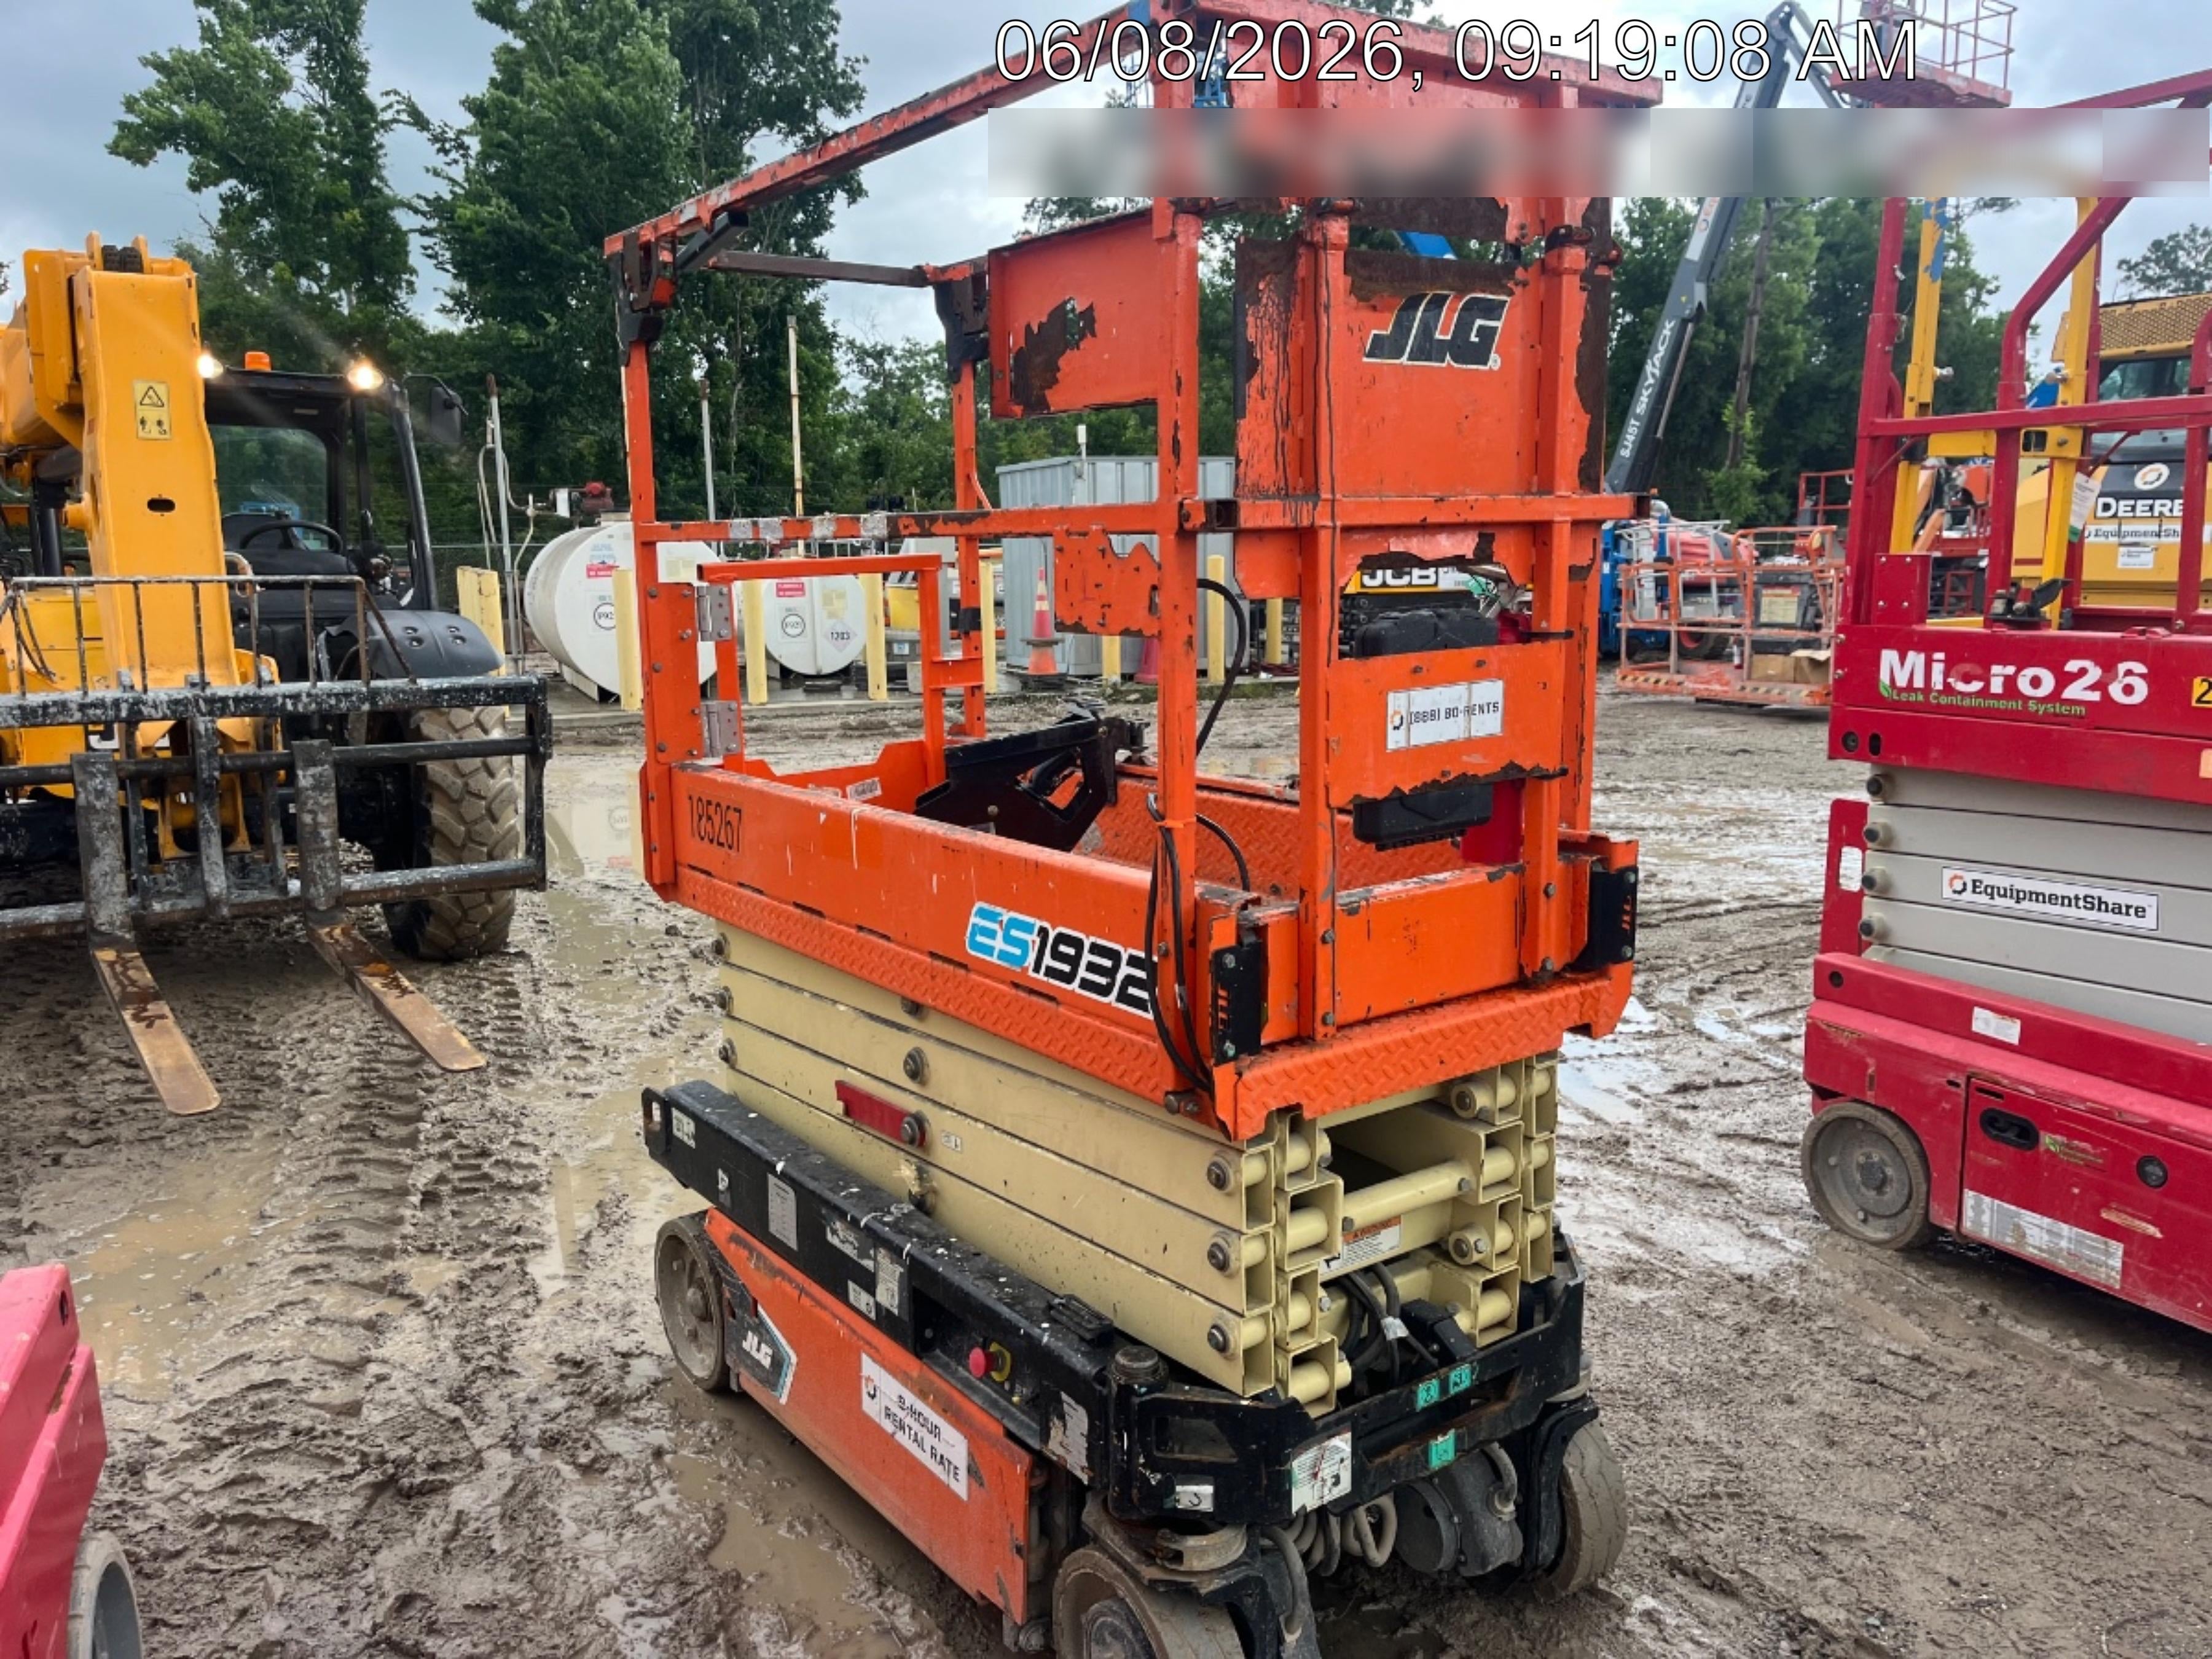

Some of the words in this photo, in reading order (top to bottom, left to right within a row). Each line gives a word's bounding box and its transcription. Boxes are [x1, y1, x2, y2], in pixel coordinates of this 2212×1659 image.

[1362, 291, 1510, 369] JLG
[1635, 318, 1676, 416] SKYJACK
[1892, 689, 1924, 702] Leak
[1929, 692, 2023, 710] Containment
[2028, 699, 2086, 716] System
[688, 794, 742, 852] 185267
[1971, 879, 2147, 919] EquipmentShare
[966, 901, 1158, 1020] ES1932
[742, 1330, 774, 1369] JLG
[884, 1405, 926, 1453] RENTAL
[930, 1445, 960, 1483] RATE
